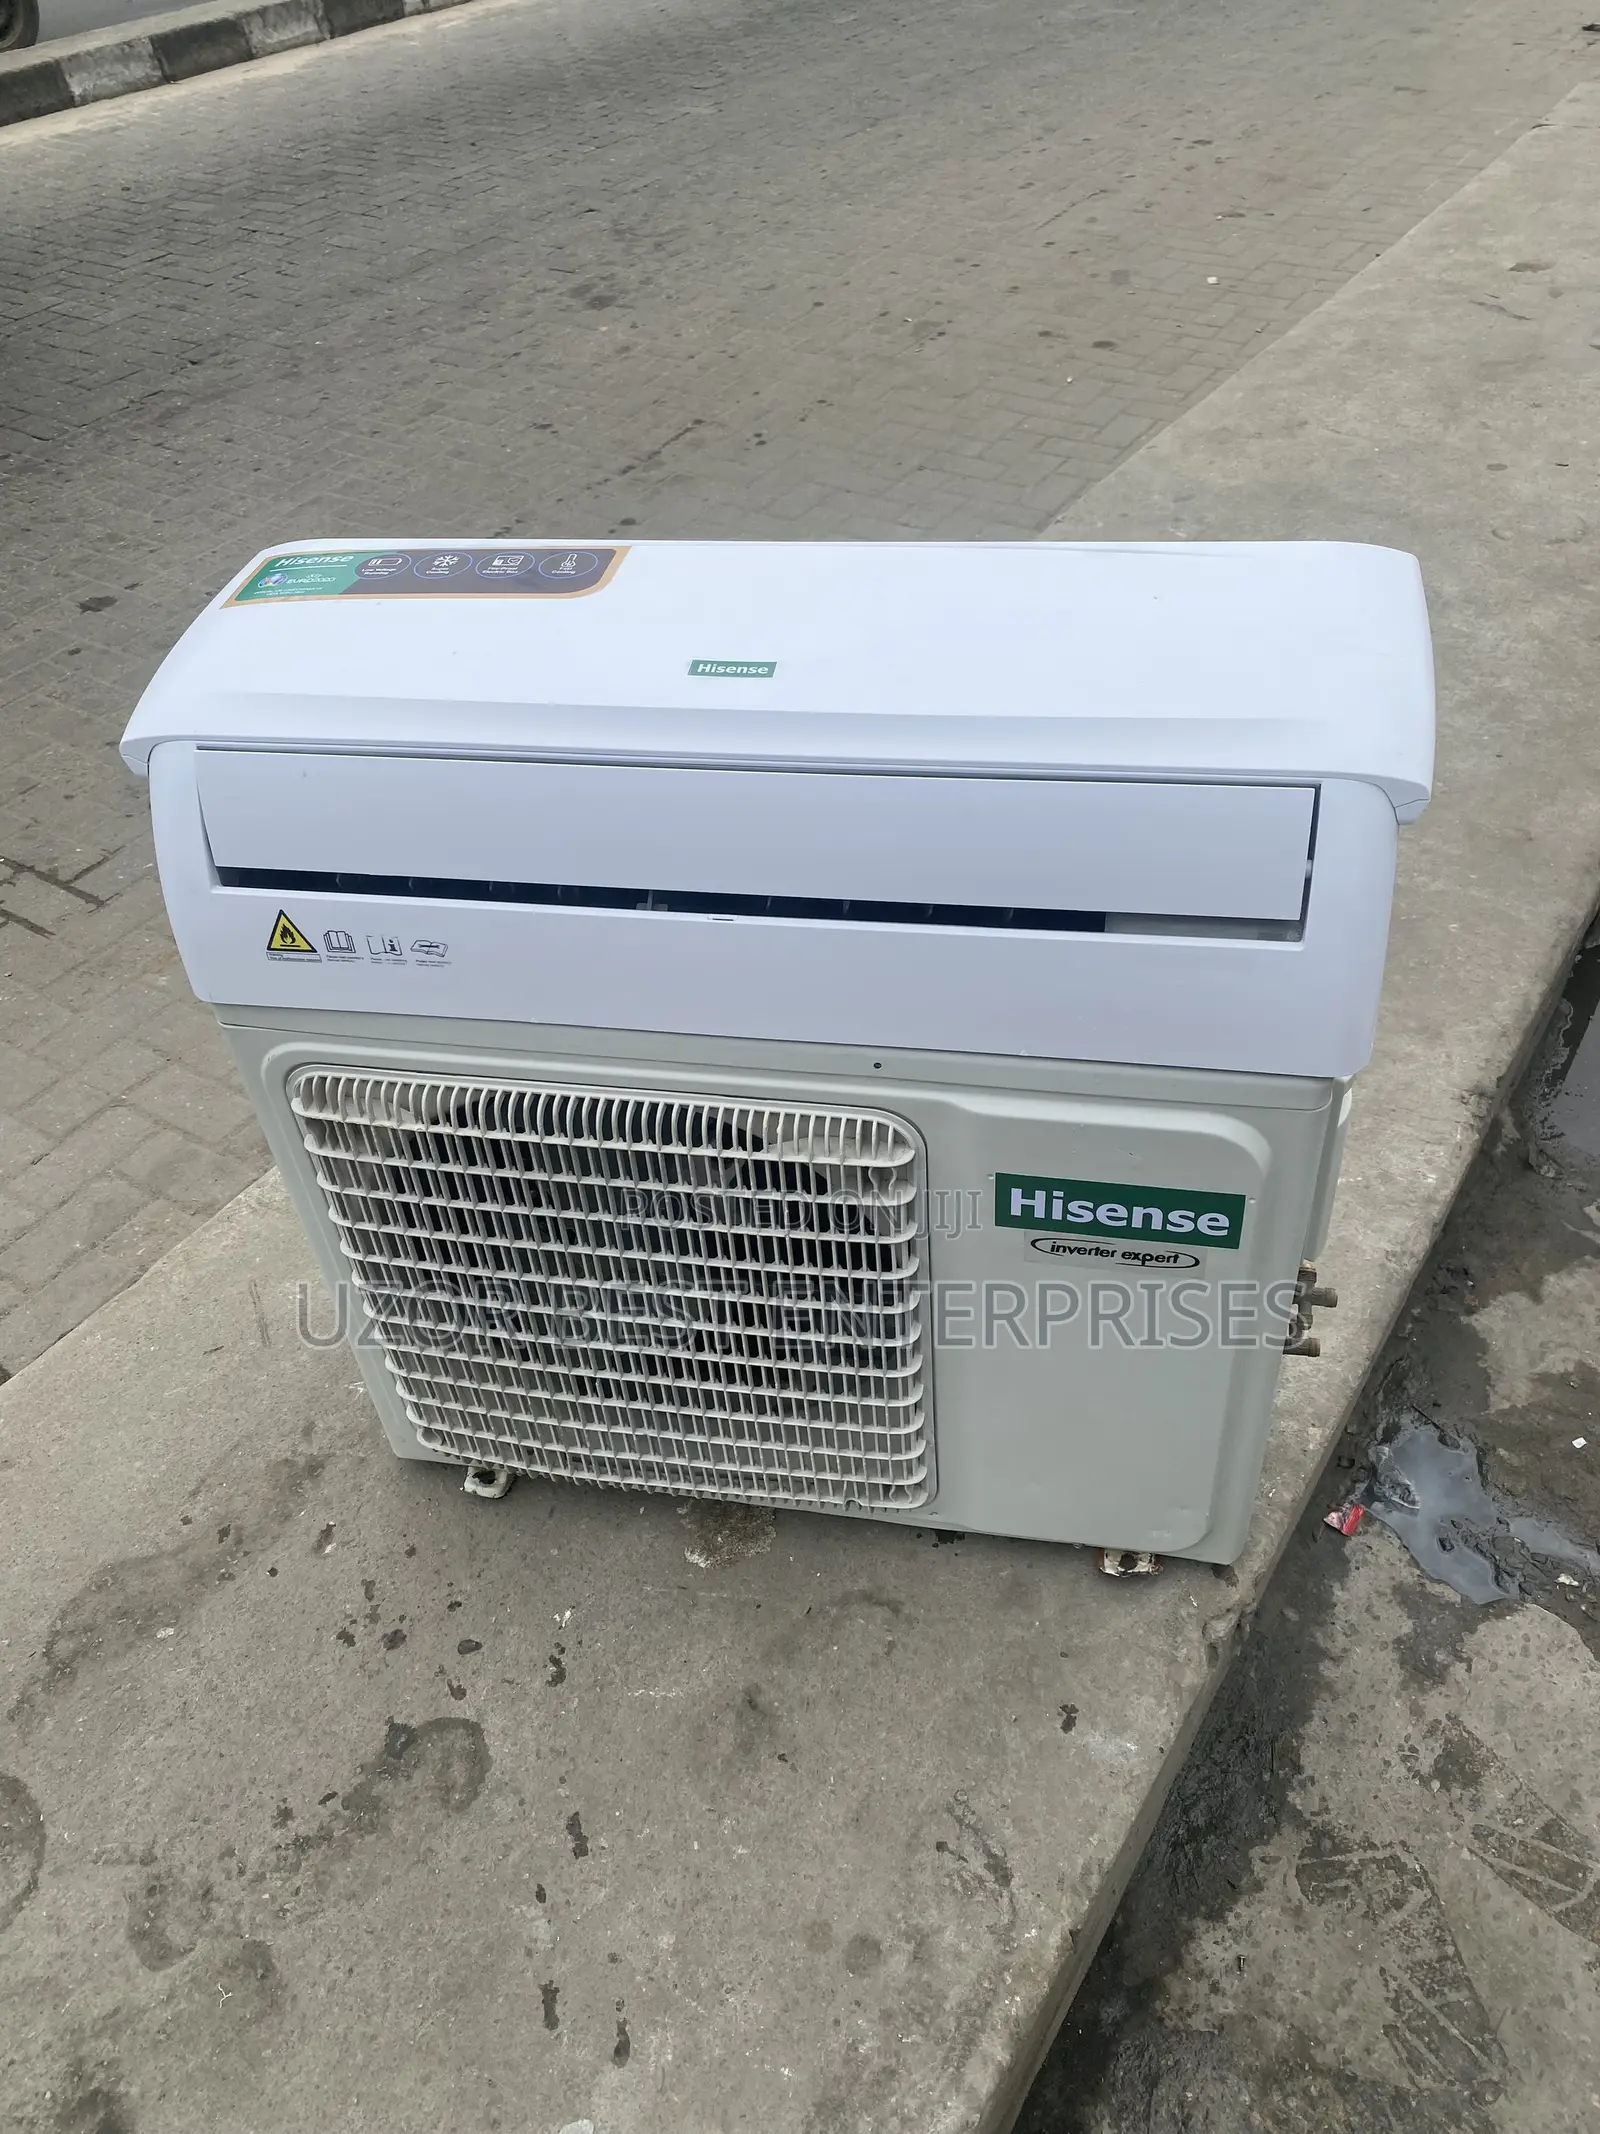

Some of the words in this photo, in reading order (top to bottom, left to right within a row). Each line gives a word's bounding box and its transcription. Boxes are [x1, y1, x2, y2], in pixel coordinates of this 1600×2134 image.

[275, 555, 354, 567] Hisense
[697, 663, 769, 674] Hisense
[1010, 1187, 1230, 1237] Hisense
[1050, 1241, 1117, 1258] inverter
[1120, 1252, 1180, 1266] expert
